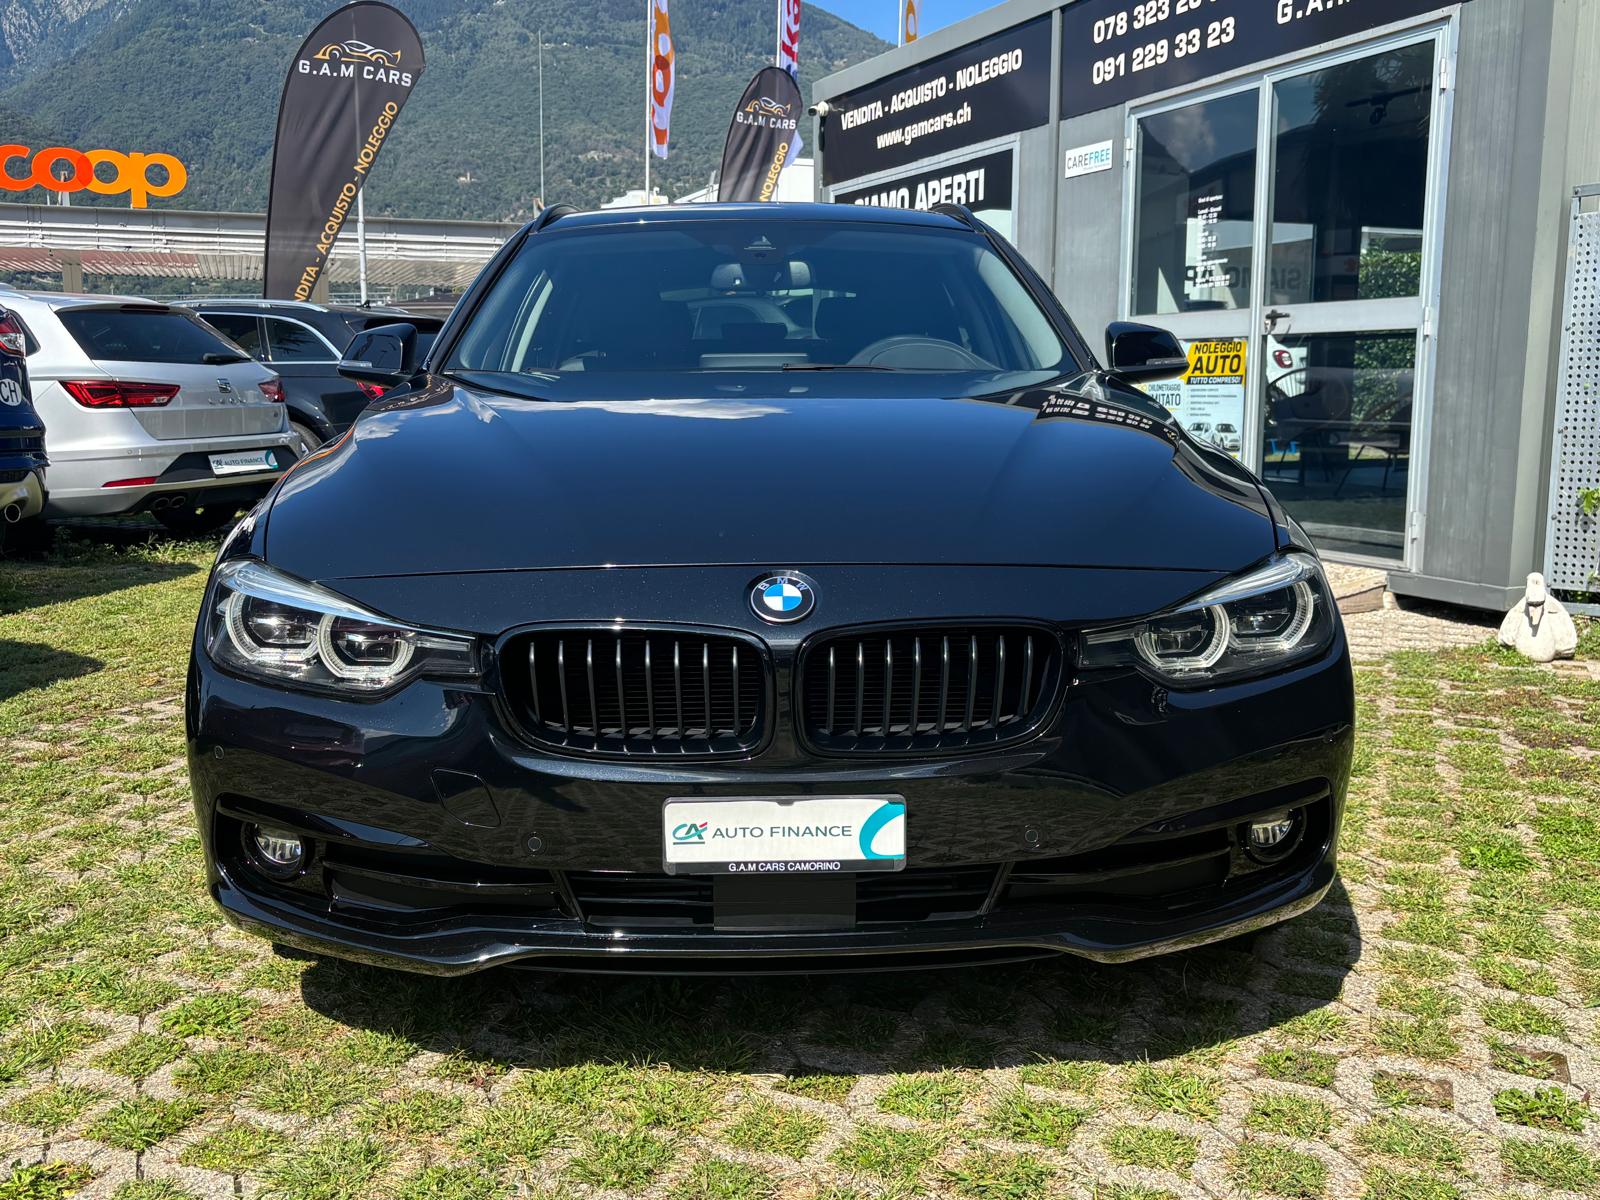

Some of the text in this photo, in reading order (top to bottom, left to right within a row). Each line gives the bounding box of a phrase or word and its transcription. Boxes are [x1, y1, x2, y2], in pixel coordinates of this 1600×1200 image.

[1093, 12, 1128, 44] 078
[1133, 0, 1170, 30] 323
[1092, 16, 1235, 85] 091 229 33 23
[298, 59, 412, 87] G.A.M CARS
[841, 101, 883, 130] VENDITA
[890, 76, 947, 114] ACQUISTO
[956, 48, 1023, 91] NOLEGGIO
[736, 111, 796, 130] G.A.M CARS
[876, 102, 972, 149] www.gamcars.ch
[1067, 148, 1111, 170] CAREFREE
[0, 145, 188, 208] coop
[316, 183, 356, 256] ACQUISTO
[354, 101, 398, 174] NOLEGGIO
[759, 142, 789, 202] NOLEGGIO
[914, 168, 985, 211] APERTI
[1194, 342, 1242, 354] NOLEGGIO
[1191, 354, 1241, 374] AUTO
[1190, 376, 1208, 384] TUTTO
[0, 381, 19, 403] CH
[224, 458, 240, 466] AUTO
[758, 576, 809, 591] BMW
[712, 827, 764, 839] AUTO
[770, 825, 853, 838] FINANCE
[728, 861, 841, 872] G.A.M CARS CAMORINO
